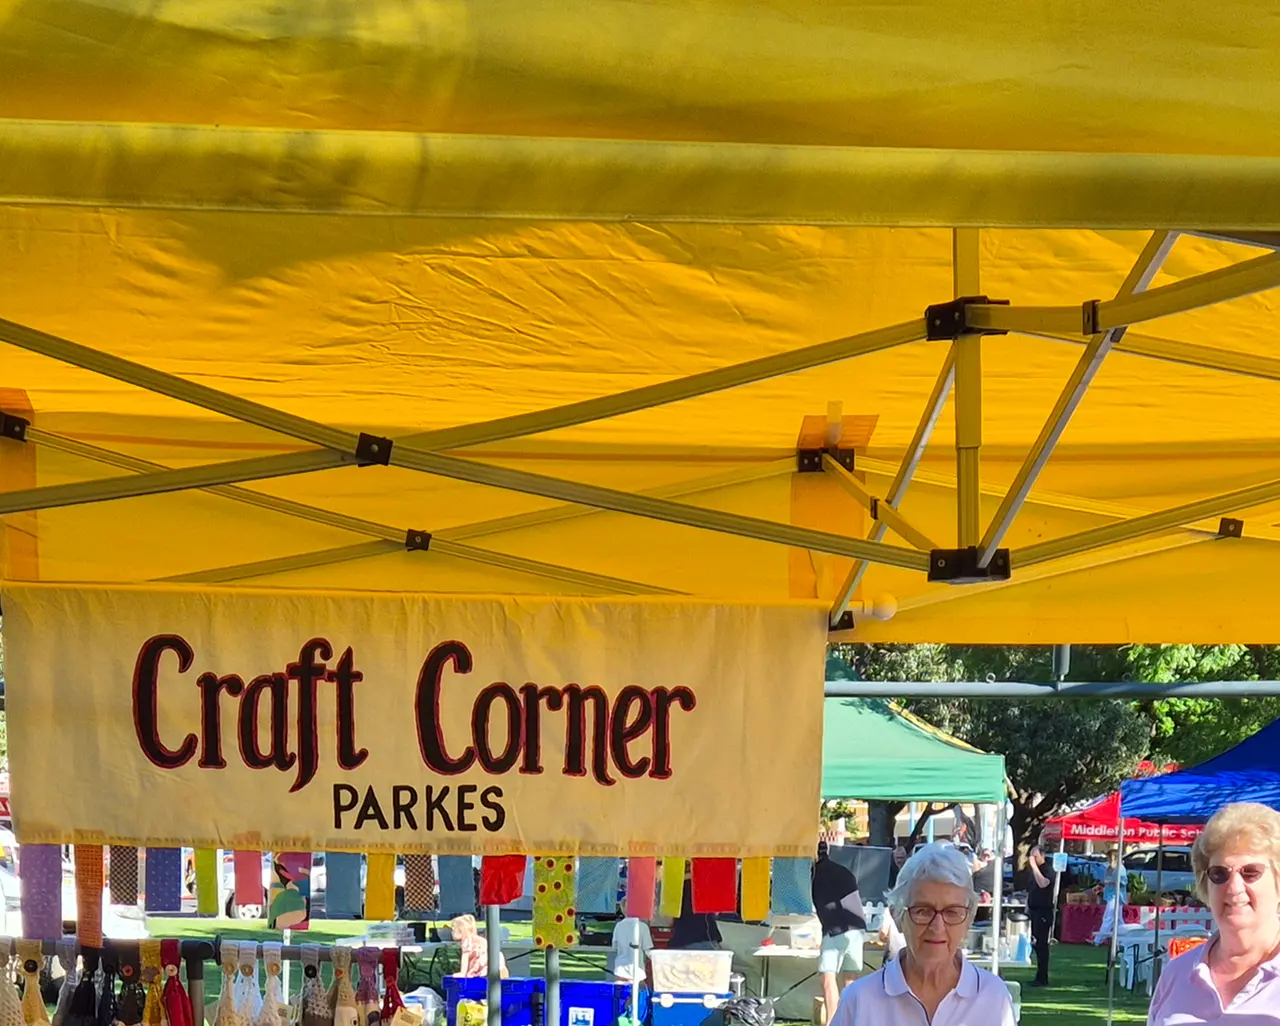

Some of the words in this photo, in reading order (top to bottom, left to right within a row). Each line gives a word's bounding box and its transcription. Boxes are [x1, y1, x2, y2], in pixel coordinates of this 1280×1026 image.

[131, 633, 369, 793] Craft
[415, 639, 697, 787] Corner
[332, 783, 507, 833] PARKES
